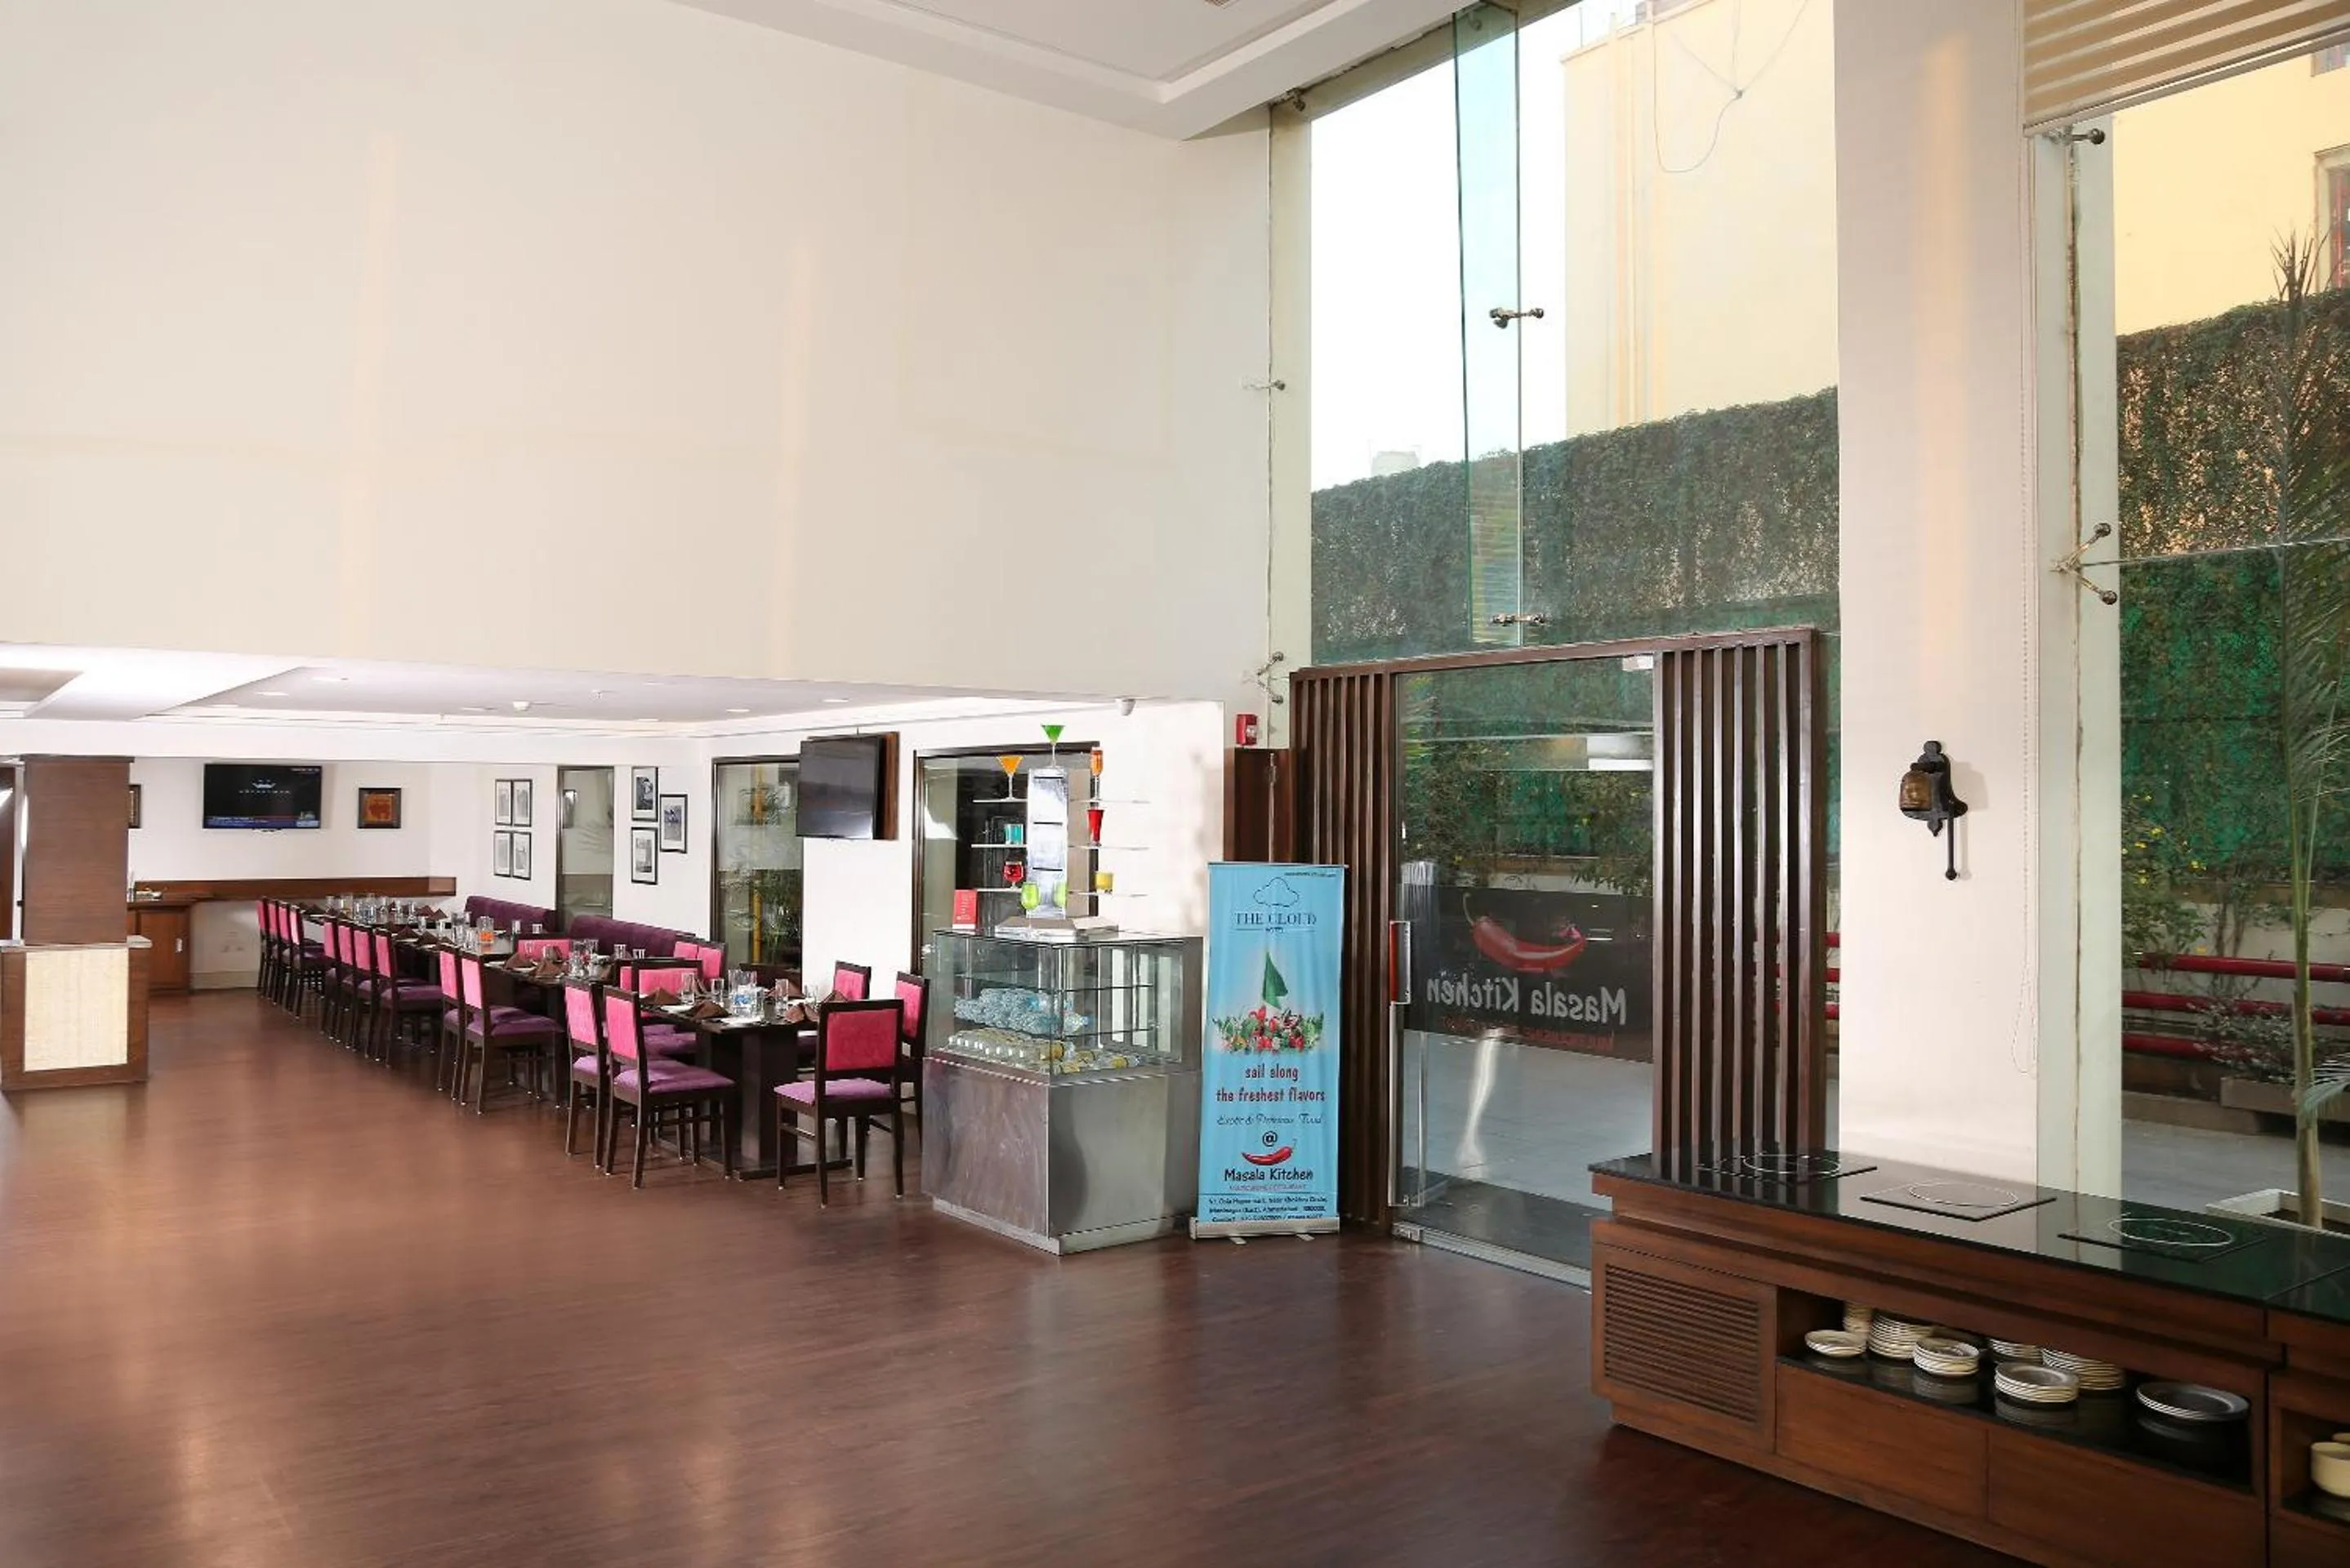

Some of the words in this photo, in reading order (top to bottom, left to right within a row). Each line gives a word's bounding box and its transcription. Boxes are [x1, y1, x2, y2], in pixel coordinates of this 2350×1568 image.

[1234, 912, 1264, 925] THE
[1268, 912, 1317, 925] CLOUD
[1246, 1063, 1264, 1080] sail
[1269, 1063, 1299, 1081] along
[1215, 1088, 1234, 1102] the
[1238, 1088, 1285, 1102] freshest
[1289, 1087, 1326, 1102] flavors
[1224, 1169, 1264, 1182] Masala
[1270, 1168, 1313, 1181] Kitchen
